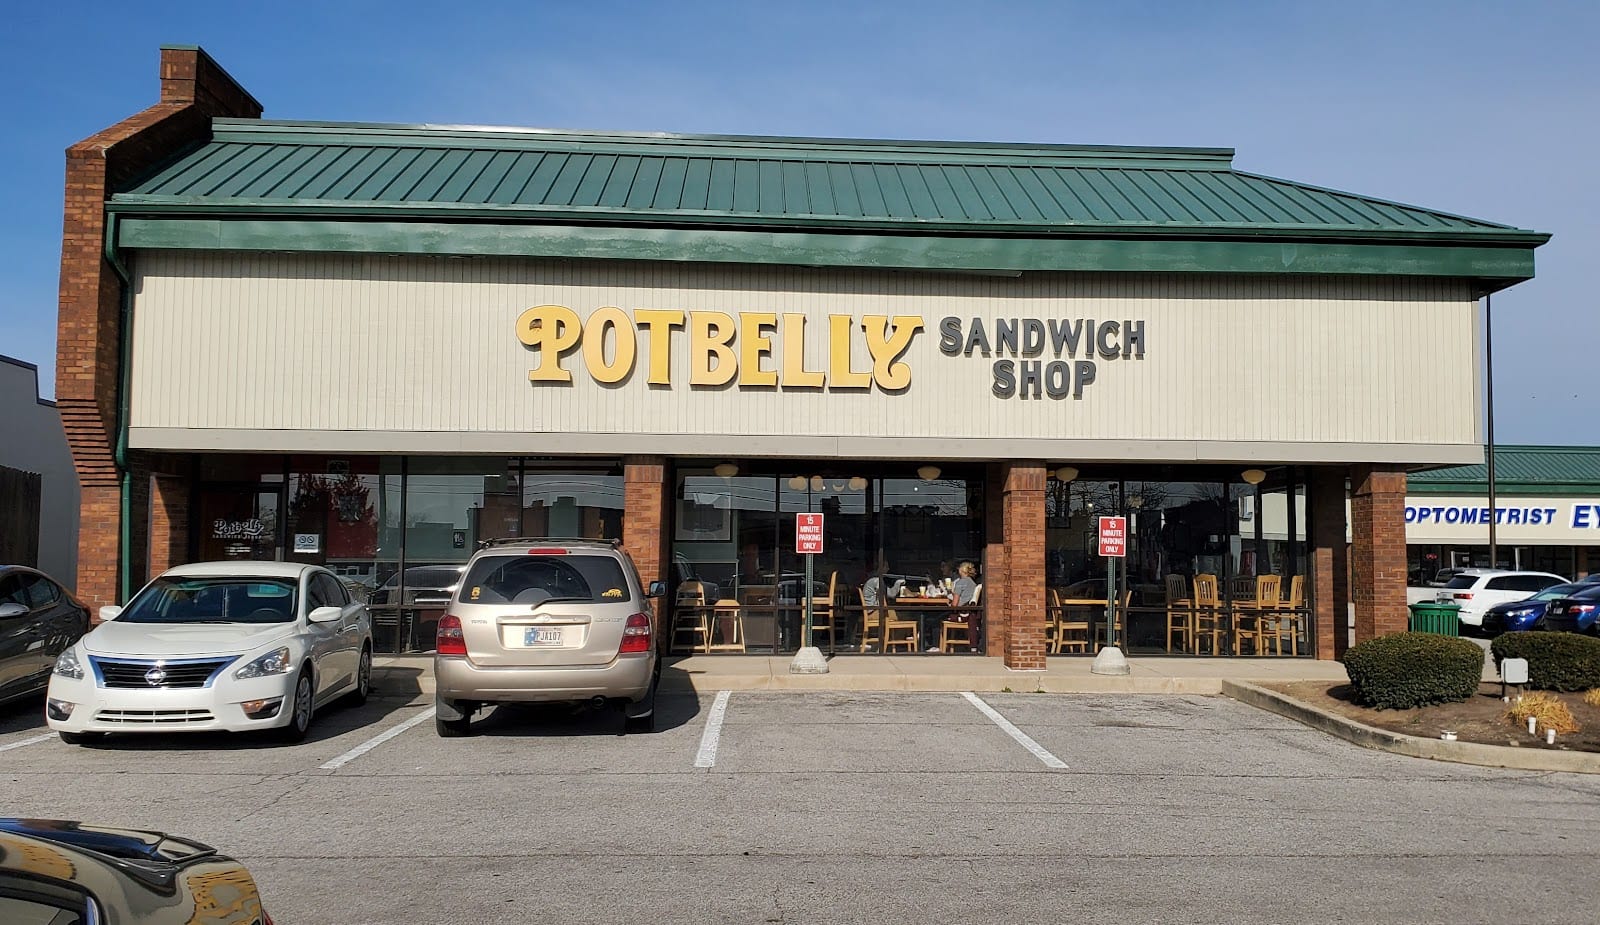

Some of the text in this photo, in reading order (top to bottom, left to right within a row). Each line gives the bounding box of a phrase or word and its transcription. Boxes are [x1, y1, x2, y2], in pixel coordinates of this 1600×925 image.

[939, 317, 1146, 359] SANDWICH
[515, 304, 925, 390] POTBELLY
[992, 360, 1097, 399] SHOP
[807, 516, 814, 524] 15
[1405, 506, 1556, 525] OPTOMETRIST
[1109, 520, 1116, 528] 15
[800, 525, 820, 533] MINUTE
[1102, 529, 1122, 537] MINUTE
[798, 533, 821, 541] PARKING
[536, 631, 561, 641] PJA107
